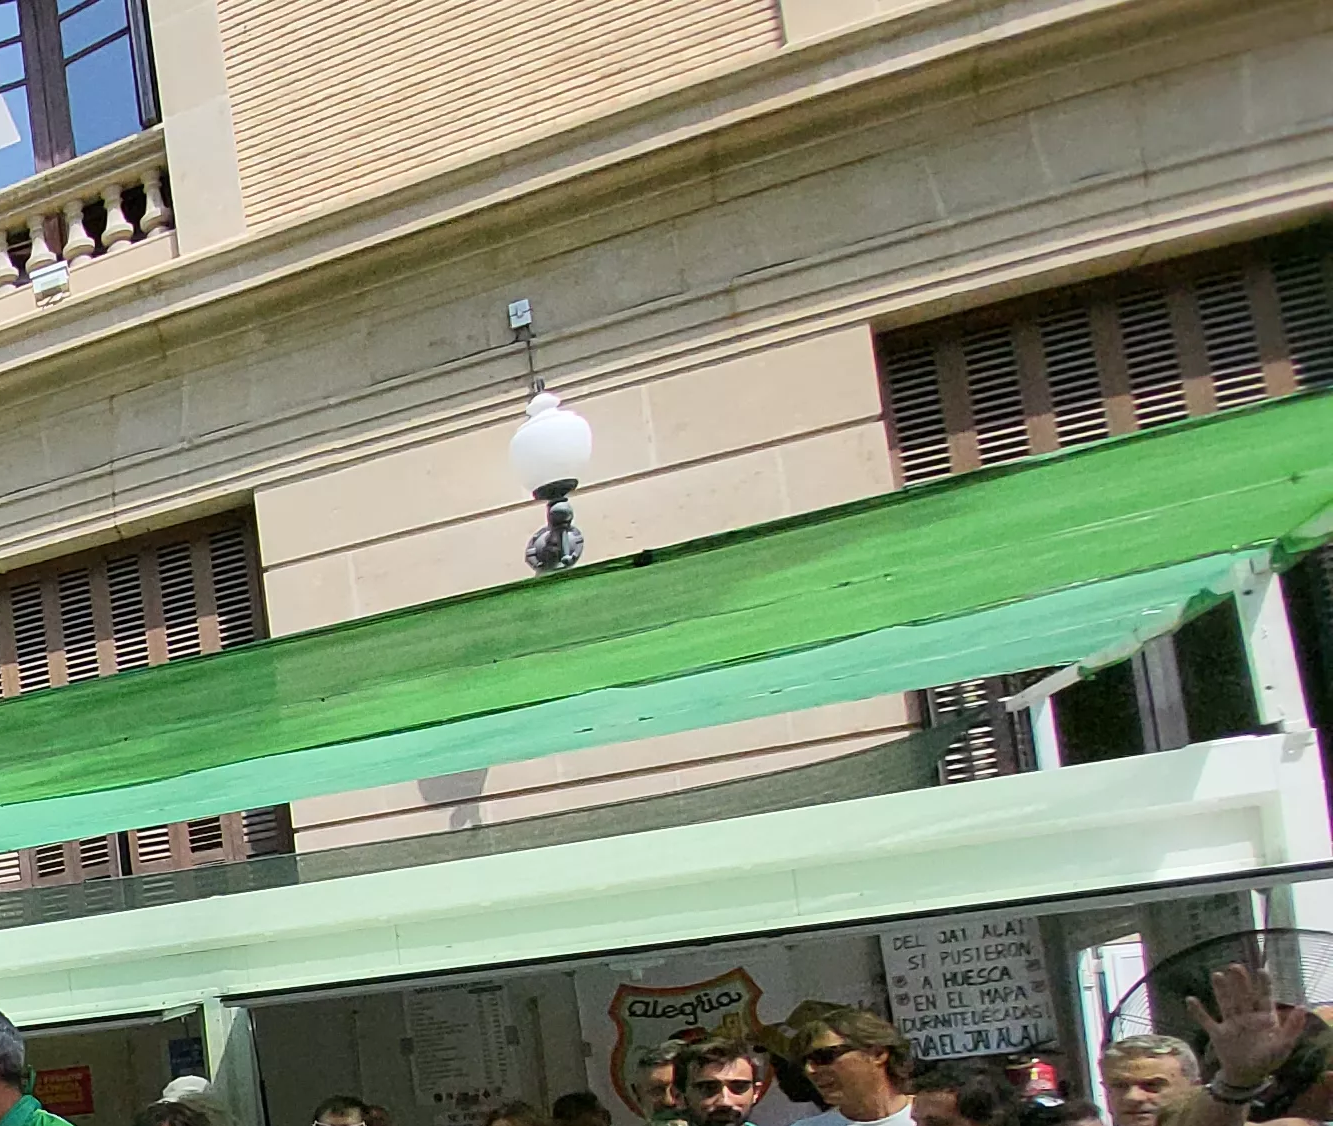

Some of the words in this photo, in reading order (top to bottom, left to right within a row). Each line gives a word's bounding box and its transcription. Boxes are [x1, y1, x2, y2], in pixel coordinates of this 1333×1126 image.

[894, 934, 925, 951] DEL
[937, 928, 967, 944] JAI
[983, 919, 1025, 939] ALAI
[908, 953, 927, 970] SI
[940, 941, 1031, 966] PUSIERON
[922, 976, 933, 989] A
[942, 966, 1013, 988] HUESCA
[913, 994, 937, 1012] EN
[946, 991, 969, 1008] EL
[980, 985, 1027, 1006] MAPA
[939, 1033, 962, 1055] EL
